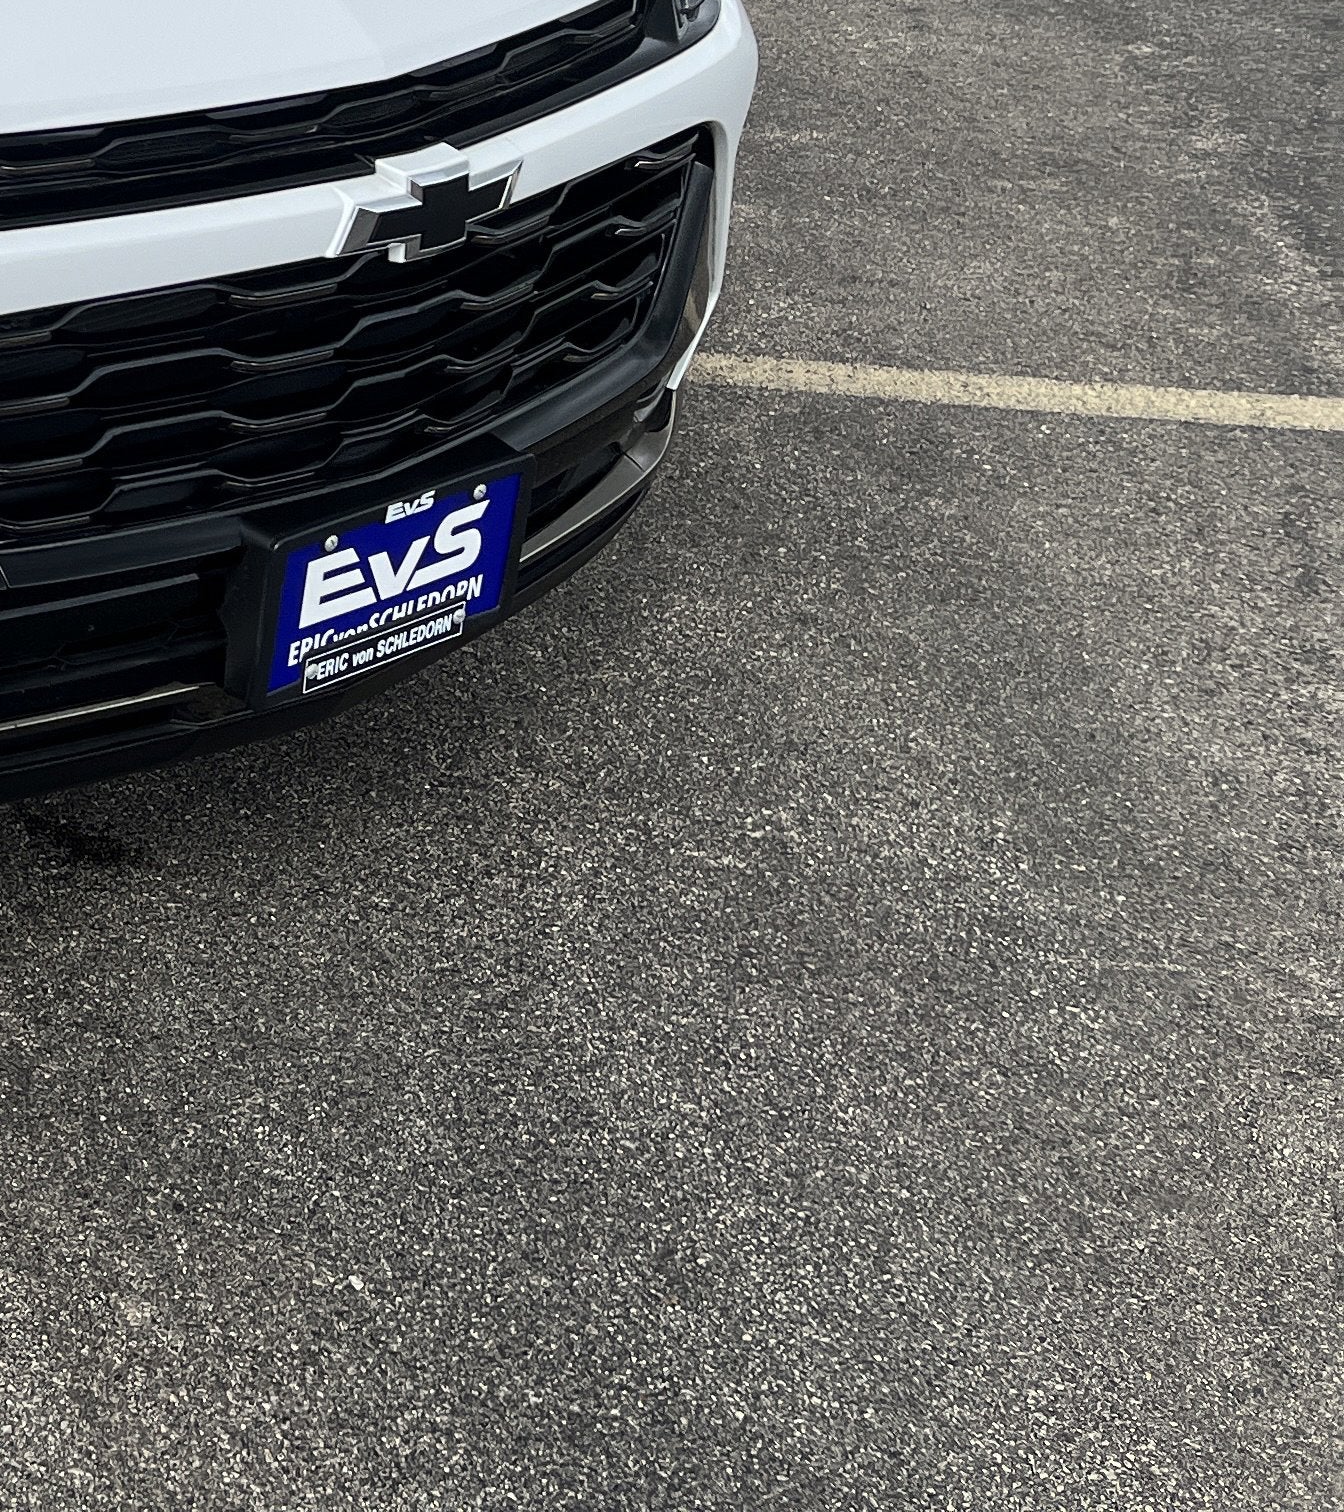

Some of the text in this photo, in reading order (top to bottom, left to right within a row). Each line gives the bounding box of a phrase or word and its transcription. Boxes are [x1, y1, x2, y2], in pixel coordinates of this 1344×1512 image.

[316, 614, 453, 681] ERIC von SCHLEDORN
